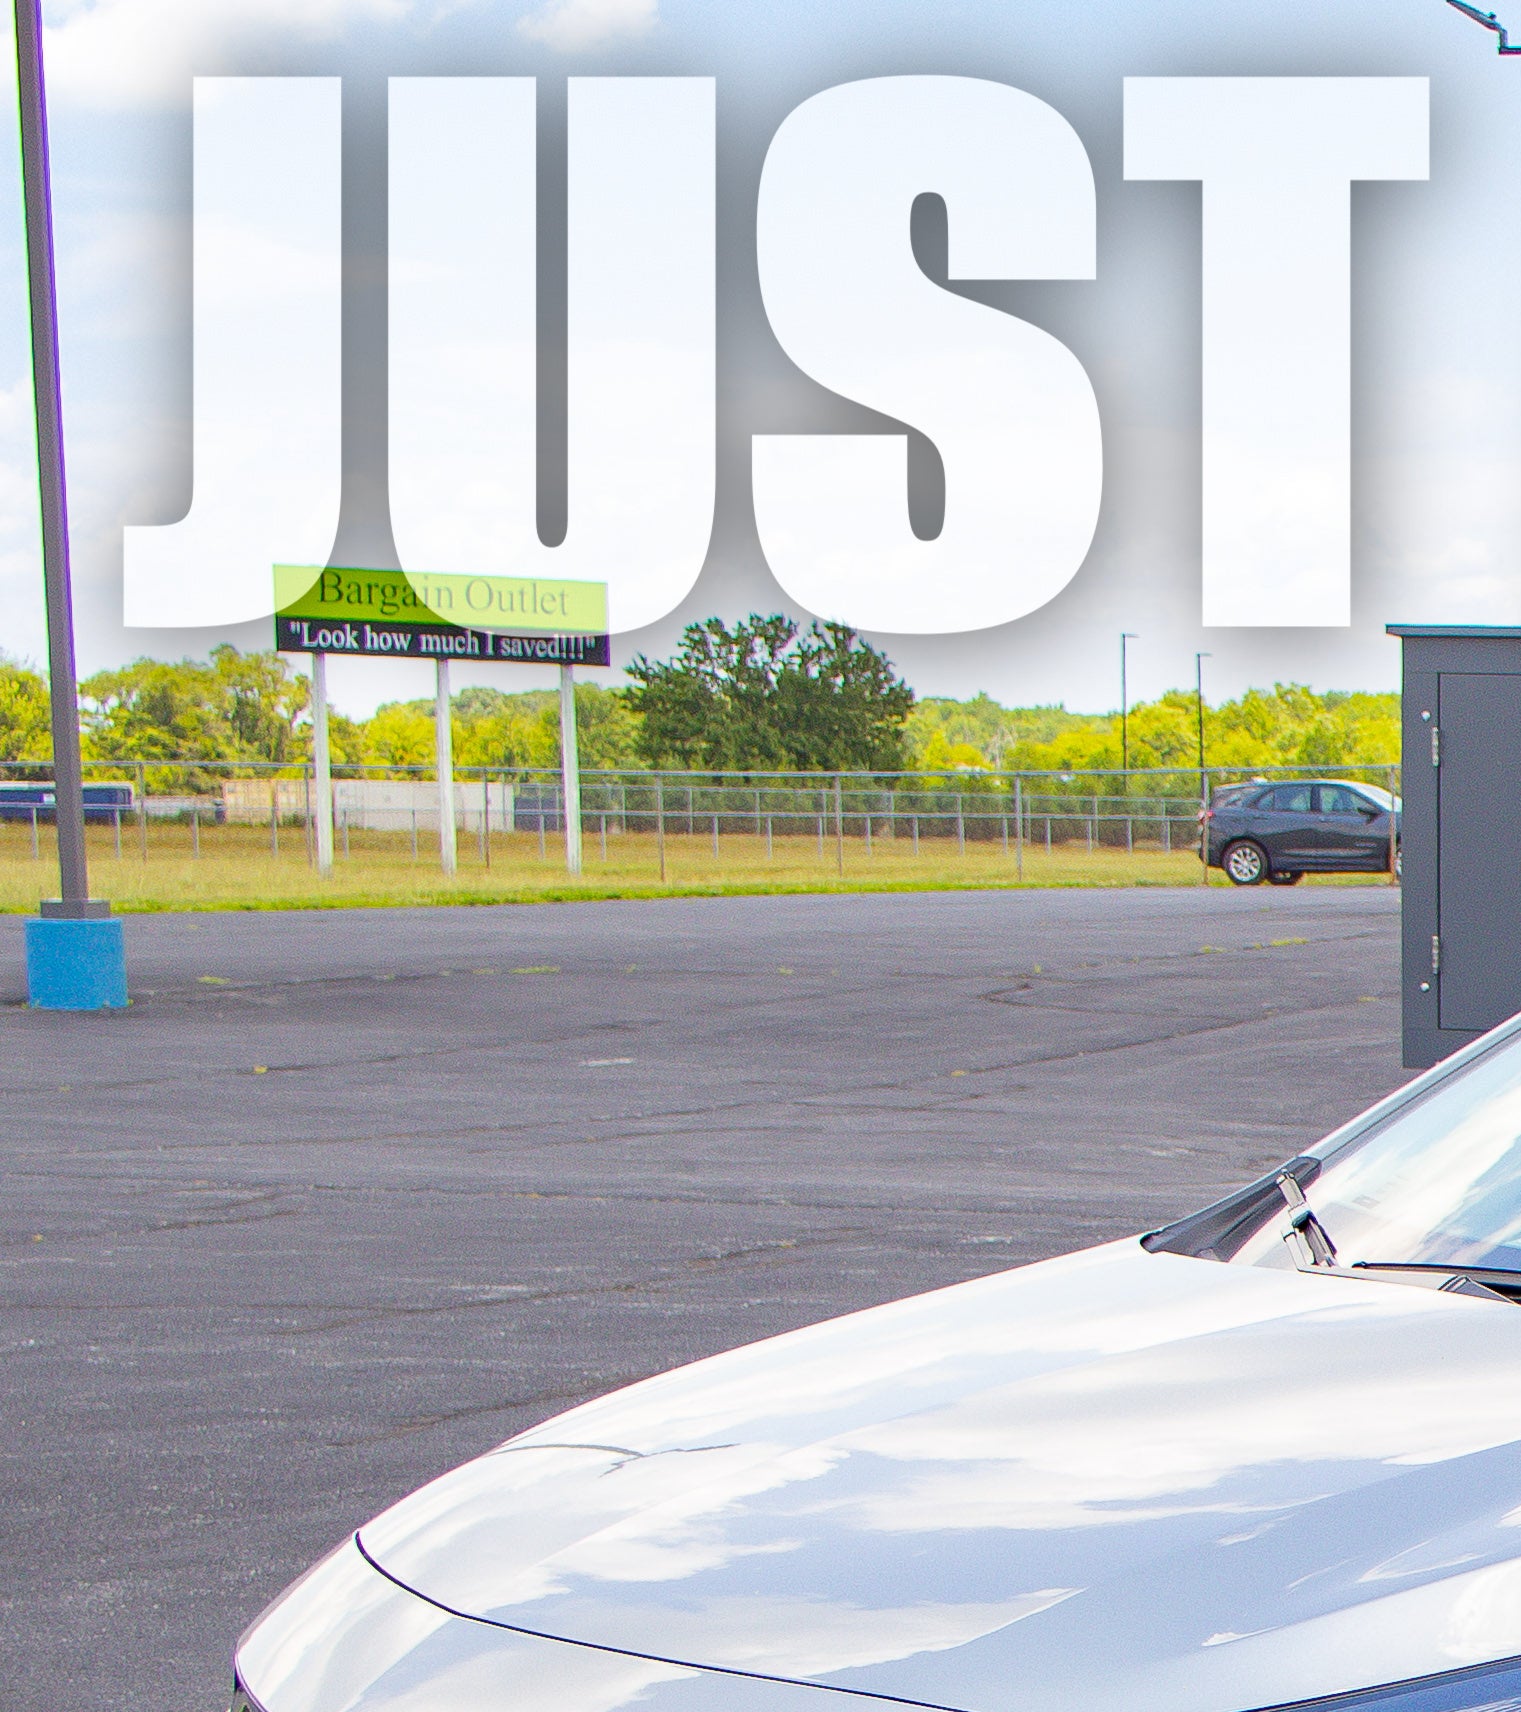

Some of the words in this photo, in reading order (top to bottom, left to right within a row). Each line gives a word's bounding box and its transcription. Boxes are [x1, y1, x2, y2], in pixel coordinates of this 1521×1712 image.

[318, 571, 454, 615] Bargain
[464, 577, 569, 617] Outlet
[289, 621, 362, 651] "Look
[364, 624, 411, 652] how
[419, 629, 480, 656] much
[485, 632, 494, 655] I
[500, 634, 596, 661] saved!!!"
